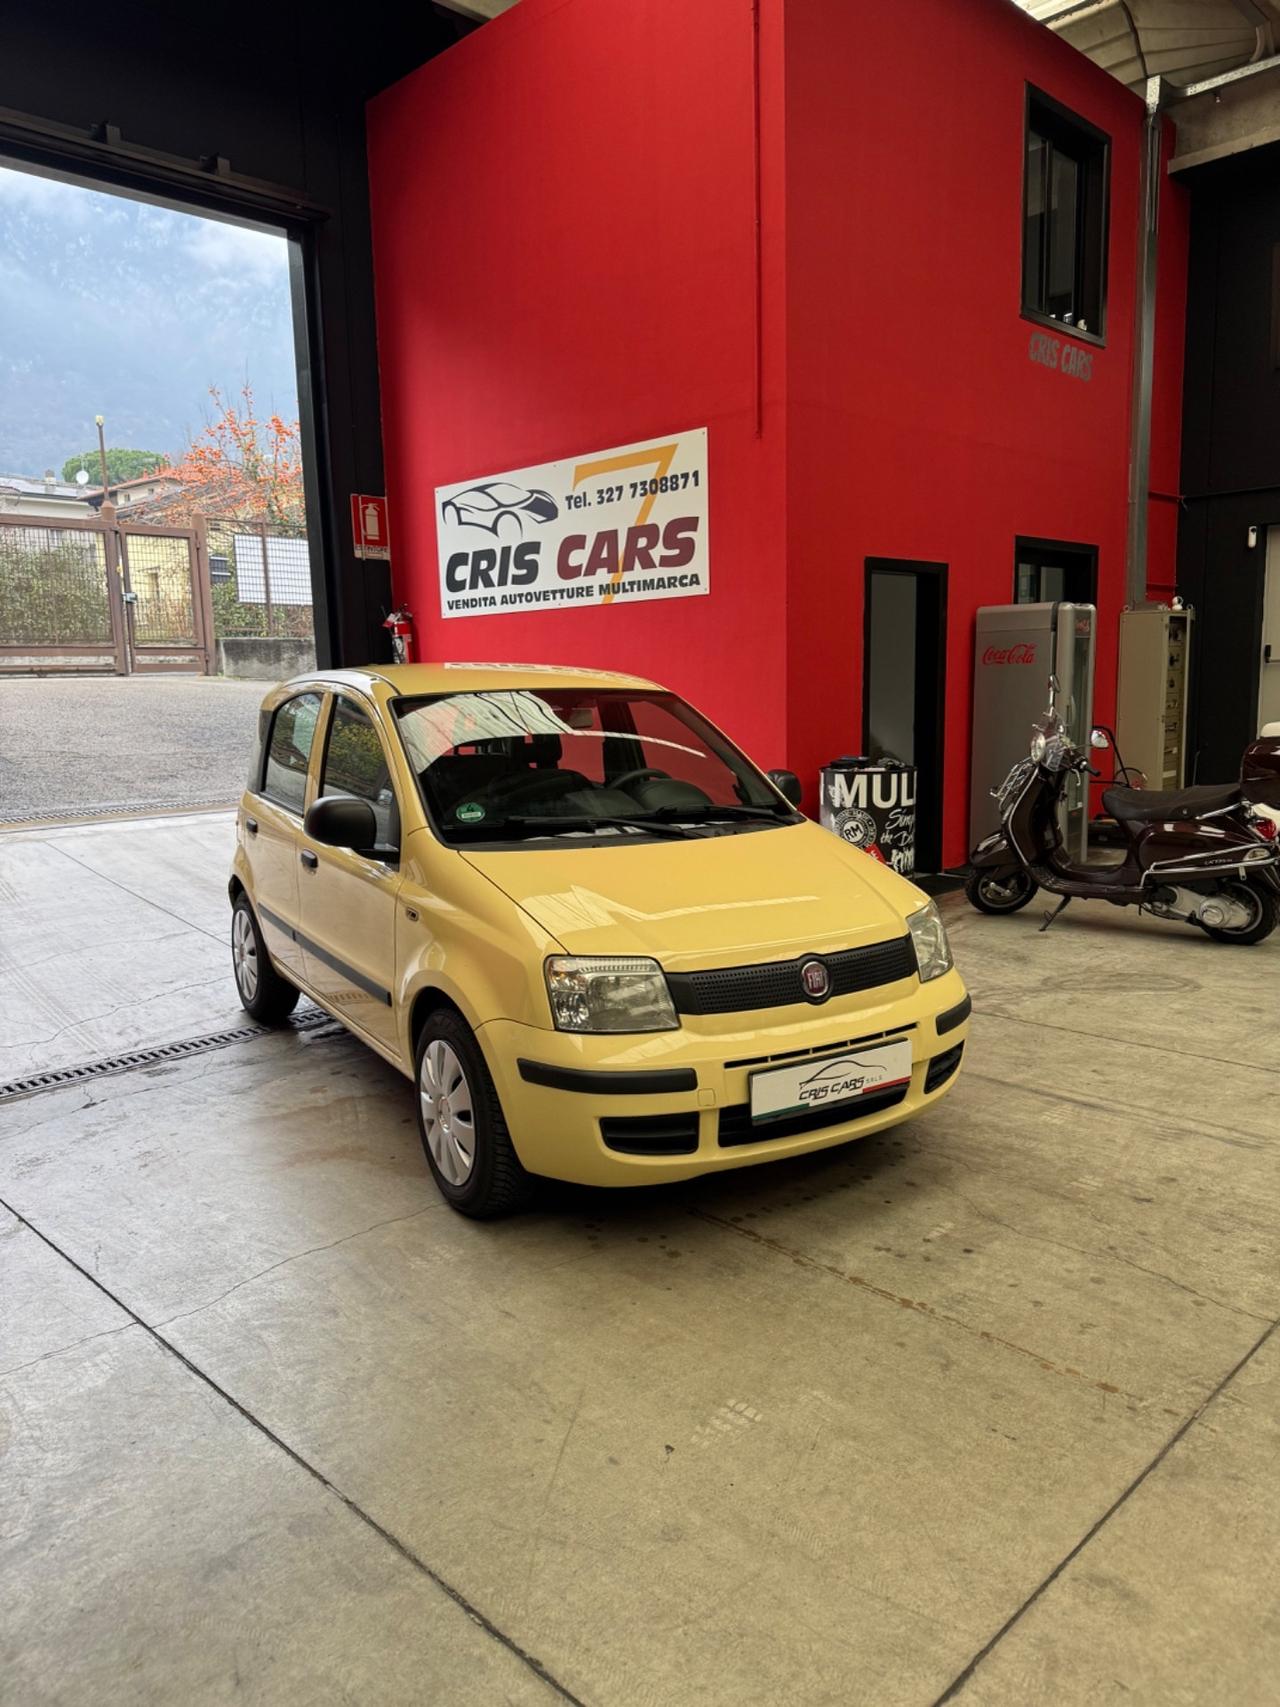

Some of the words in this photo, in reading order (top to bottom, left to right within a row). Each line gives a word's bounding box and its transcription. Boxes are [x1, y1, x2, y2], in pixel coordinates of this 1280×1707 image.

[1028, 331, 1059, 369] CRIS
[1061, 344, 1093, 383] CARS
[565, 492, 592, 510] Tel.
[596, 485, 623, 505] 327
[630, 470, 700, 498] 7308871
[445, 541, 541, 593] CRIS
[556, 516, 700, 580] CARS
[447, 596, 497, 610] VENDITA
[500, 585, 594, 605] AUTOVETTURE
[598, 573, 701, 596] MULTIMARCA
[844, 823, 864, 840] RM
[807, 970, 824, 989] FIAT
[799, 1085, 829, 1100] CRIS
[831, 1076, 865, 1094] CARS
